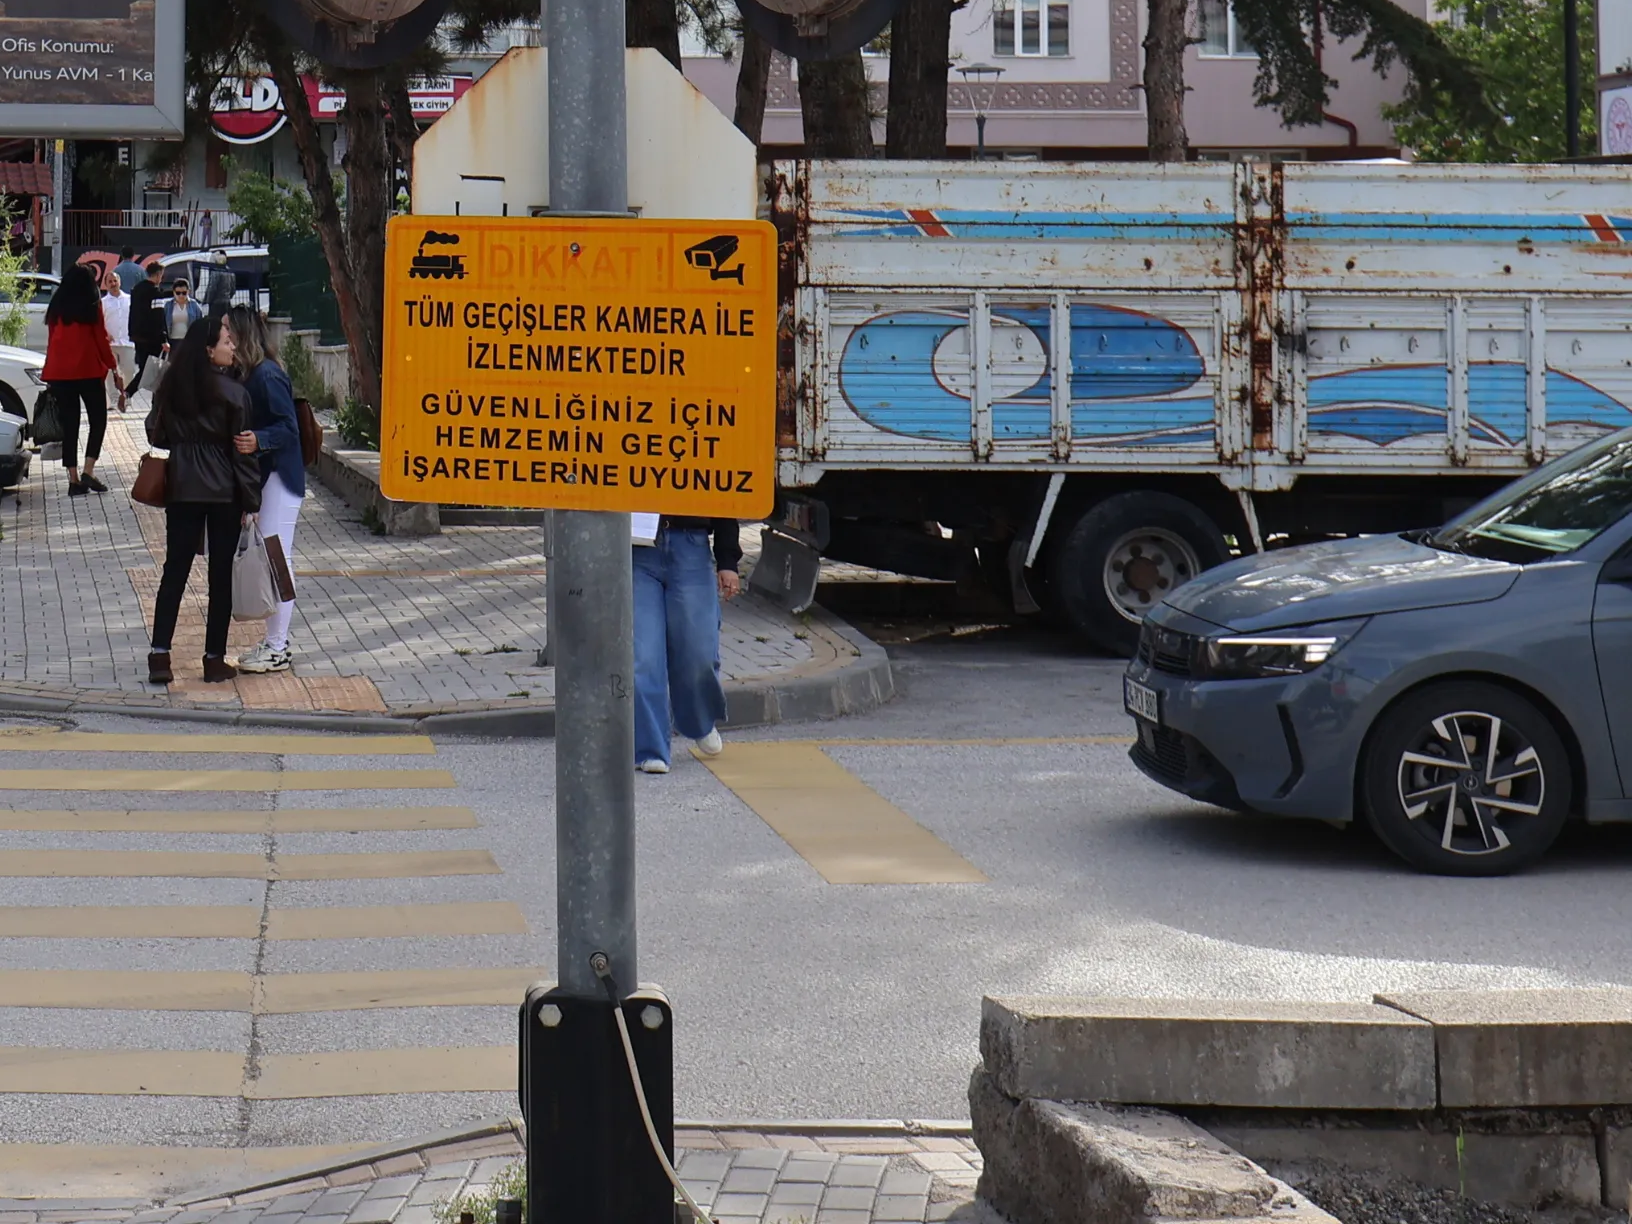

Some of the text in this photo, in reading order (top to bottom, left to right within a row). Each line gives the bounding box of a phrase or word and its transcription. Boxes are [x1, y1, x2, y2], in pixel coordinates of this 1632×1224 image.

[1, 38, 115, 54] Ofis Konumu:
[1, 65, 52, 81] Yunus
[56, 67, 99, 82] AVM
[118, 68, 126, 82] 1
[132, 68, 154, 82] Ka
[489, 236, 641, 281] DİKKAT
[404, 294, 755, 337] TÜM GEÇİŞLER KAMERA İLE
[467, 335, 686, 376] İZLENMEKTEDİR
[421, 388, 736, 431] GÜVENLİĞİNİZ İÇİN
[435, 425, 721, 463] HEMZEMİN GEÇİT
[403, 450, 754, 494] İŞARETLERİNE UYUNUZ
